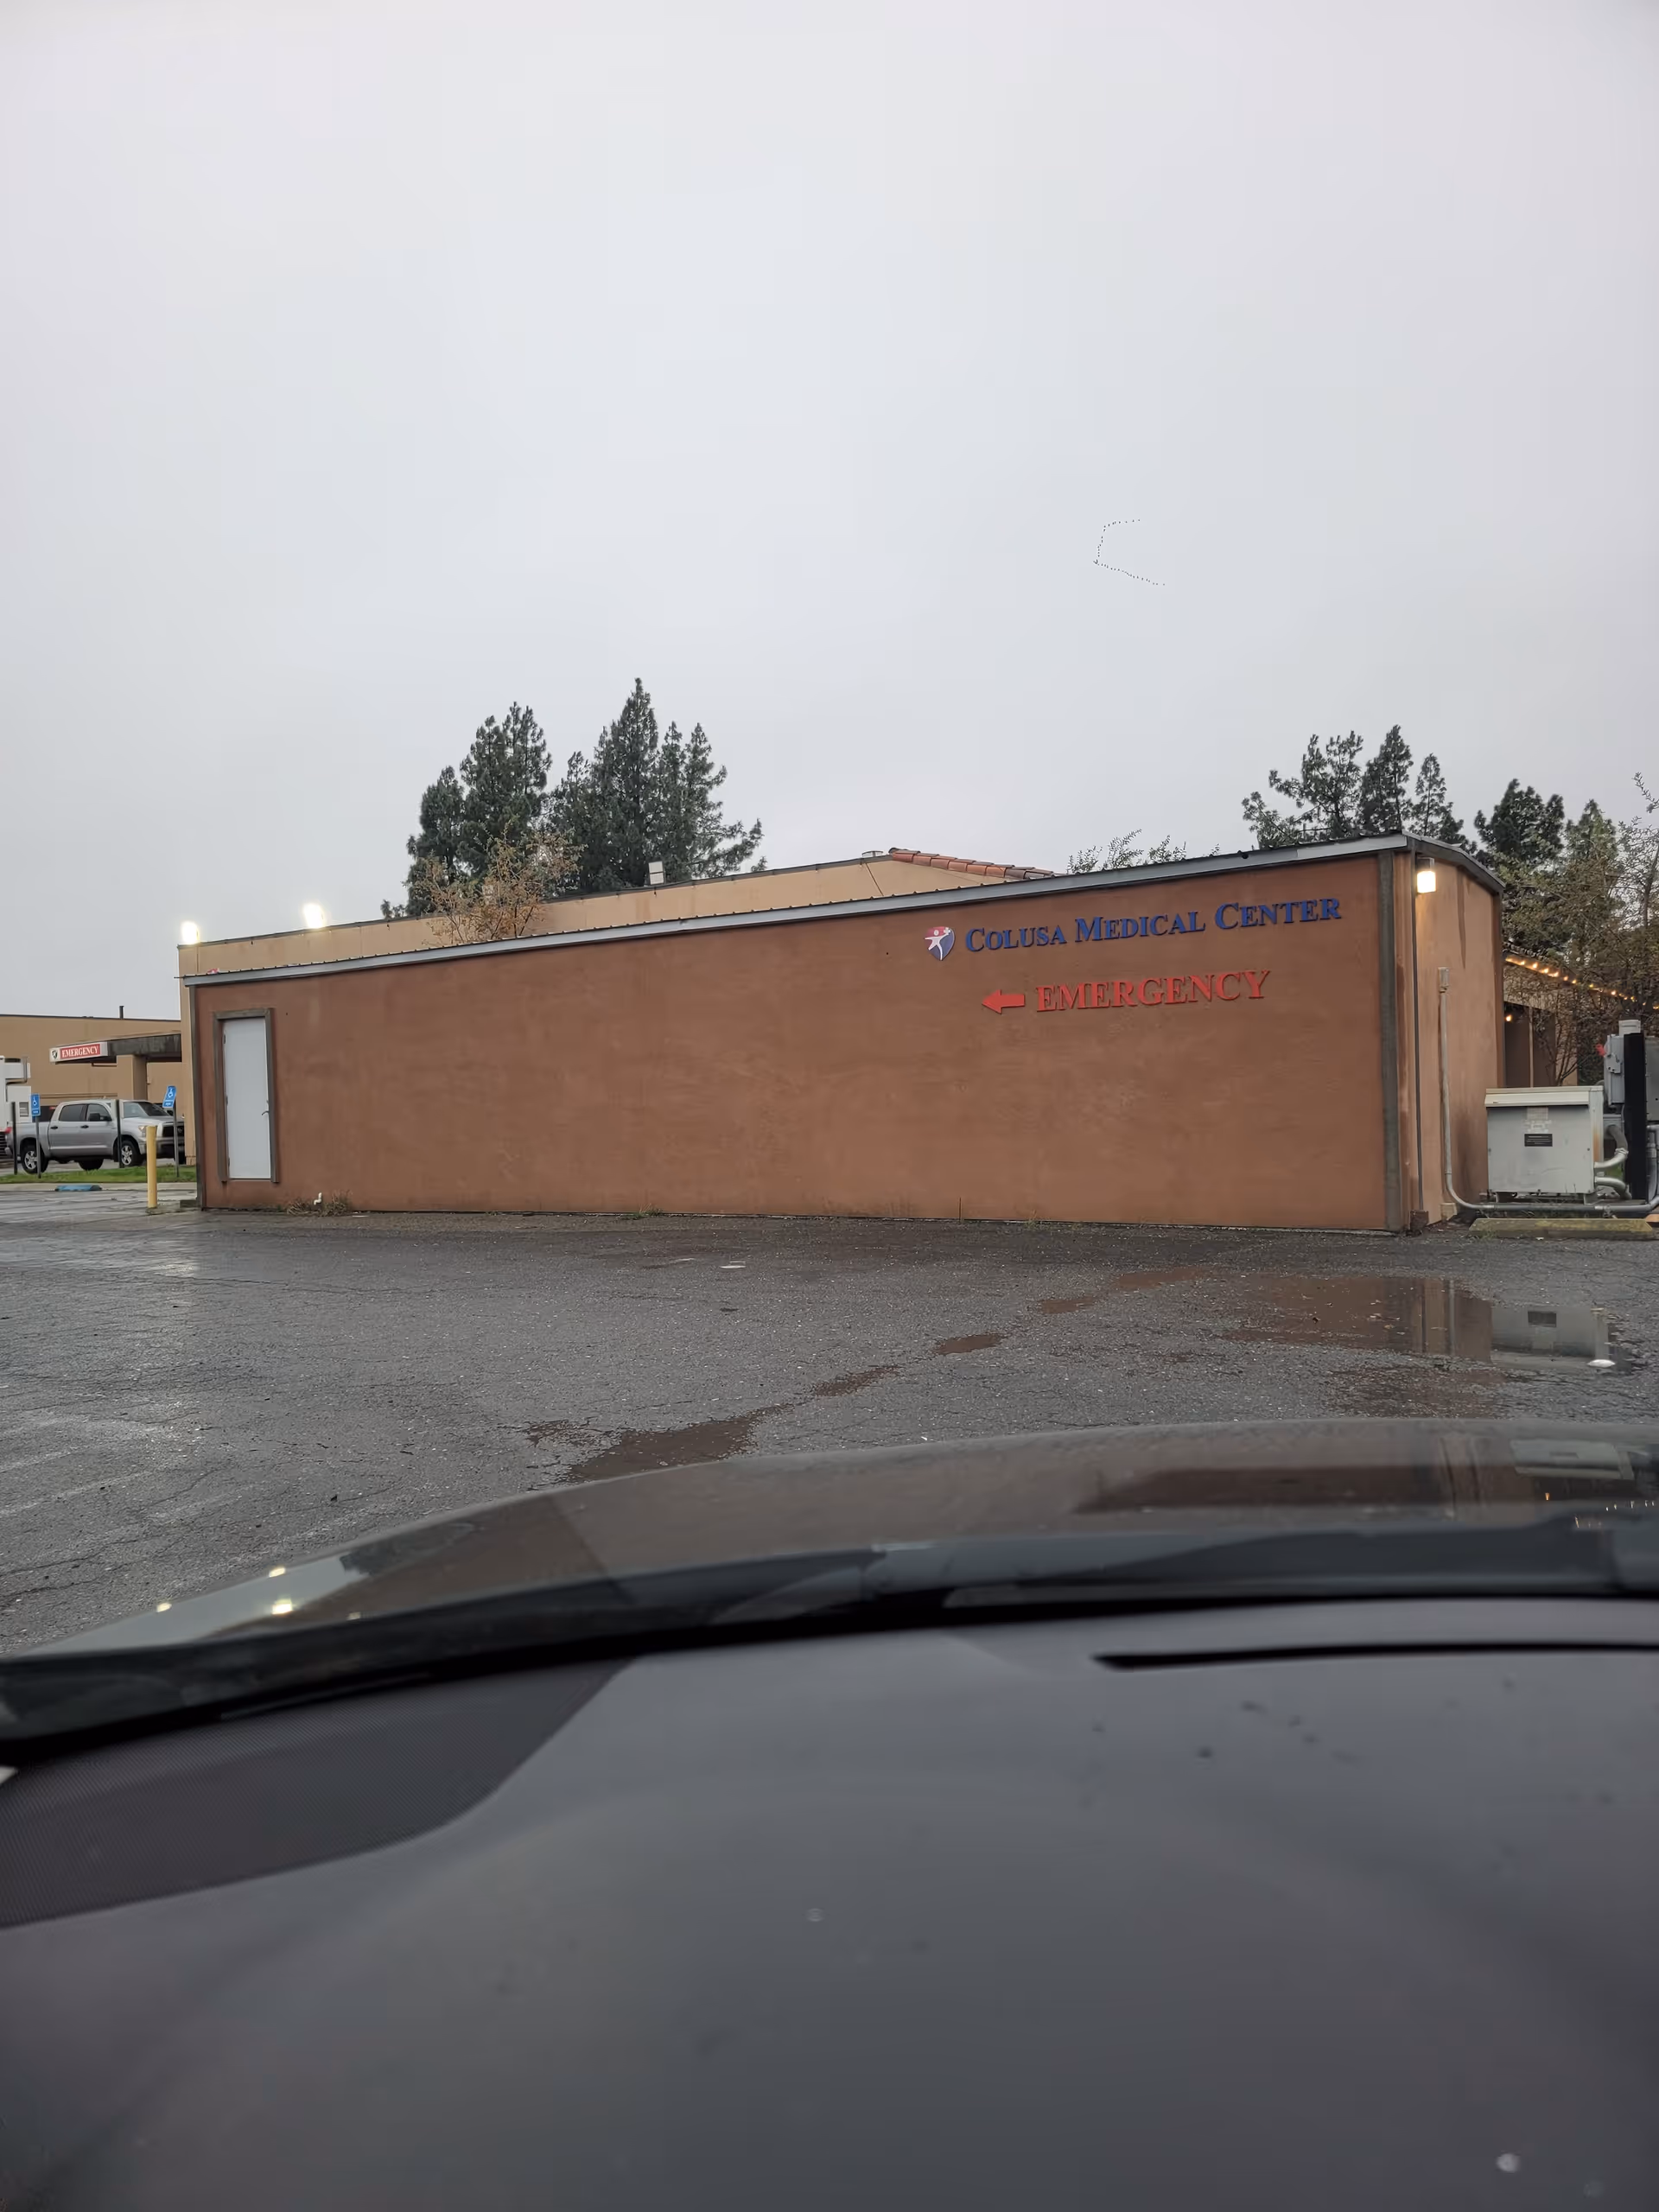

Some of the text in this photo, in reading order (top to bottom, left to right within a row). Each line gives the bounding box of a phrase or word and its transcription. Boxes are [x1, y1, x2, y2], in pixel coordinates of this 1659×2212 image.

[965, 897, 1342, 952] COLUSA MEDICAL CENTER
[1036, 969, 1270, 1012] EMERGENCY
[61, 1045, 99, 1058] EMERGENCY
